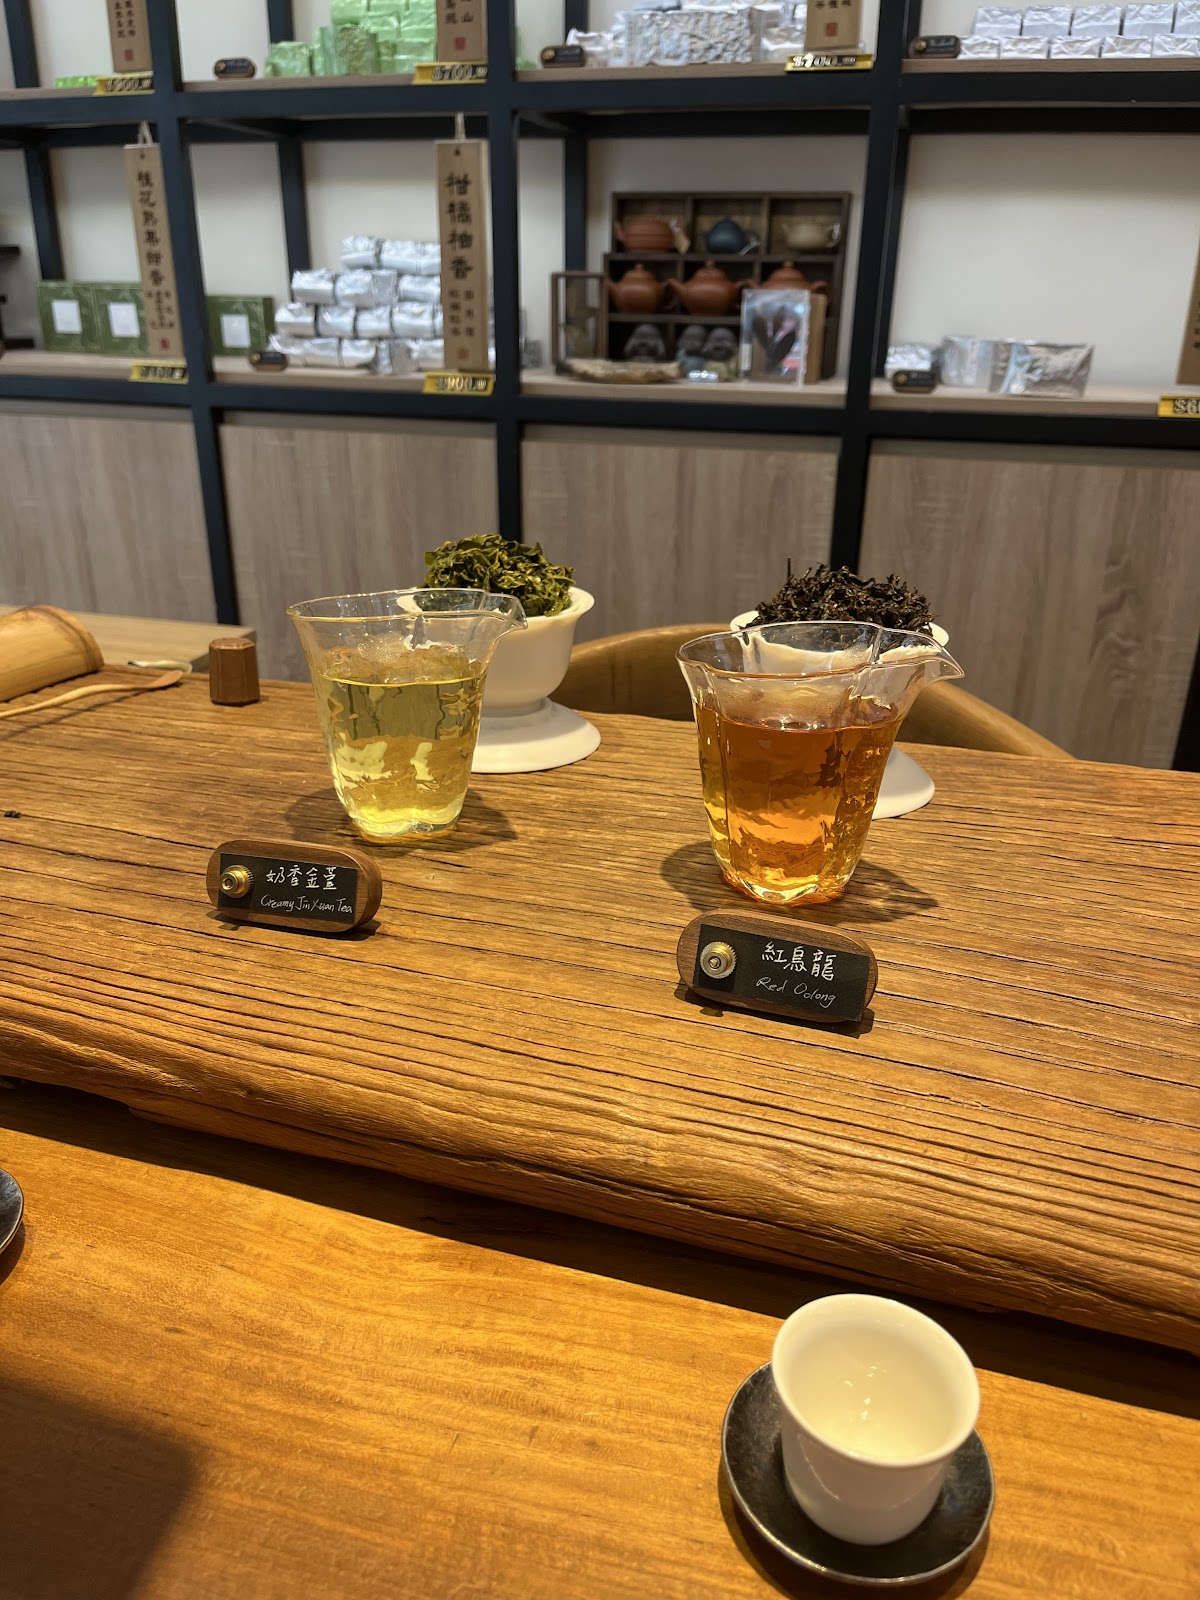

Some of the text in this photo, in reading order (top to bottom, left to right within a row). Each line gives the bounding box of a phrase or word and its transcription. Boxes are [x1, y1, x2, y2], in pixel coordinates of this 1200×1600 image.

[444, 172, 473, 281] 柑橘柚香
[265, 864, 338, 891] 奶香金萱
[260, 894, 295, 912] Creamy
[336, 897, 353, 914] Tea
[761, 940, 838, 982] 紅烏龍
[755, 976, 837, 1009] Red Oolong
